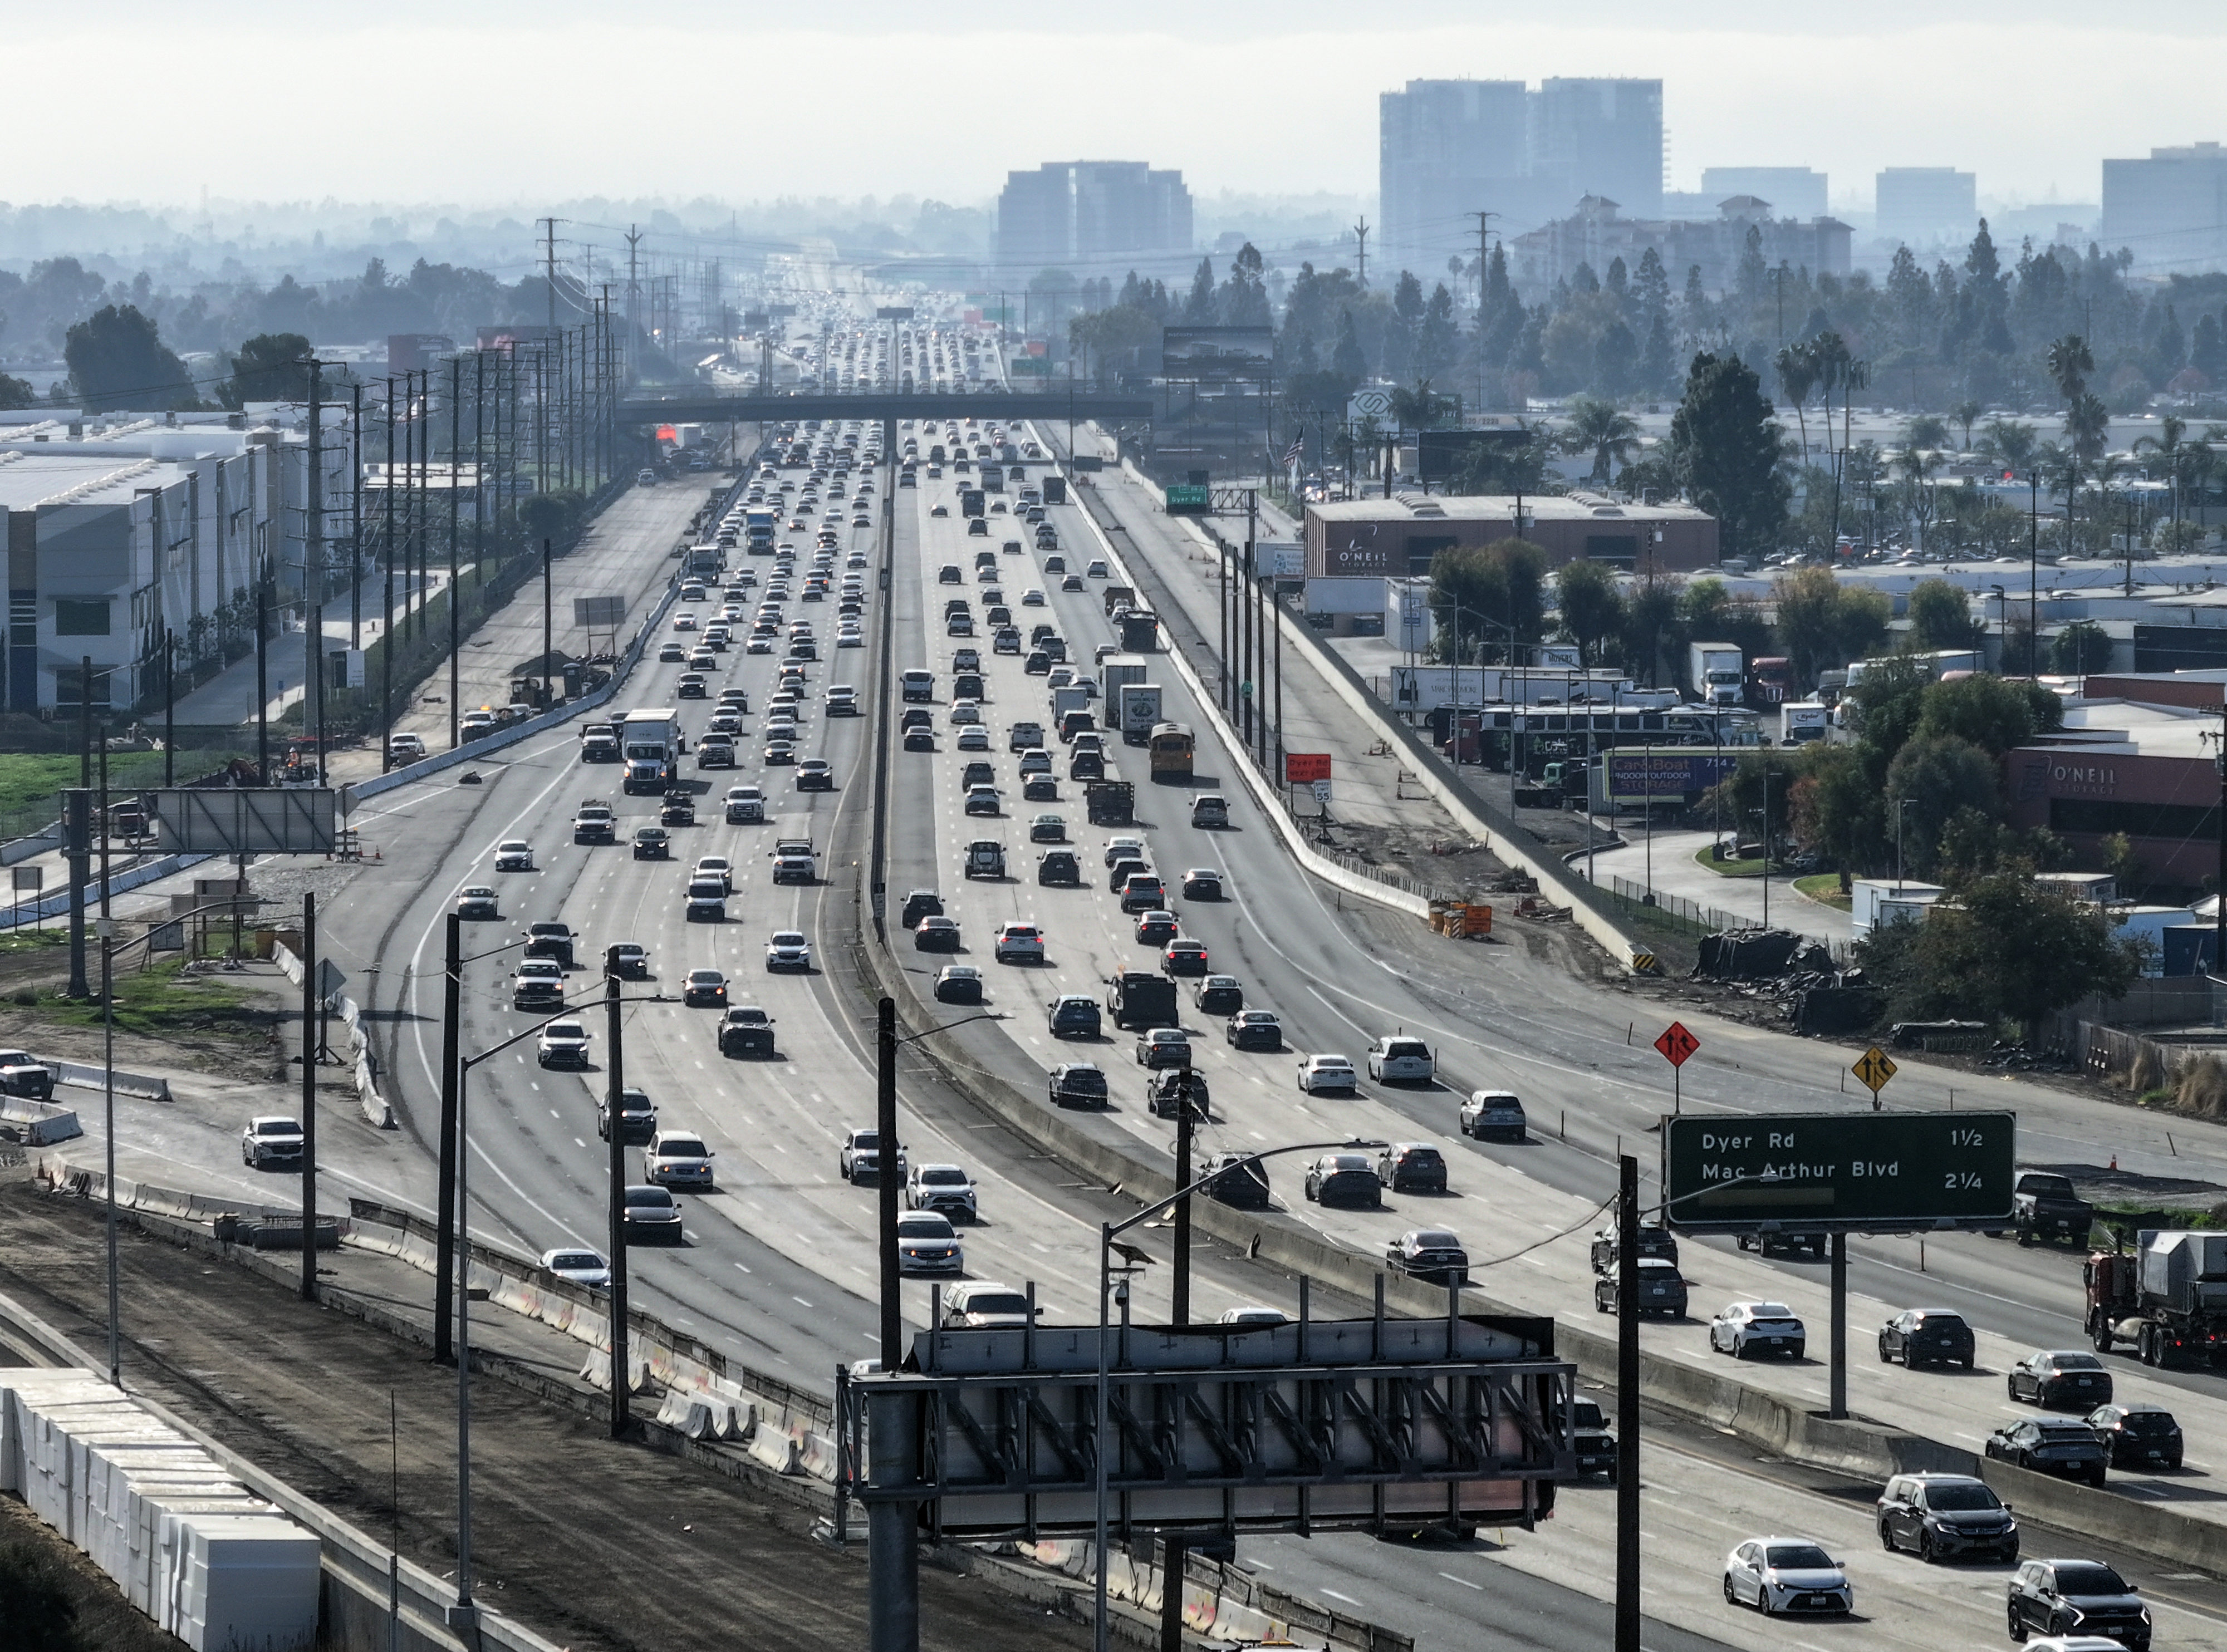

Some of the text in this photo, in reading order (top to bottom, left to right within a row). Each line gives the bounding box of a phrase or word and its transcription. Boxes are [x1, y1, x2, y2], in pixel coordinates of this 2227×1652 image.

[1339, 552, 1388, 562] O'NEIL
[1548, 654, 1573, 662] MOVERS
[2054, 766, 2117, 785] O'NEIL
[1621, 780, 1685, 789] STORAGE
[2057, 785, 2115, 795] STORAGE
[1703, 1132, 1794, 1153] Dyer Rd
[1703, 1161, 1899, 1179] Mac Arthur Blvd
